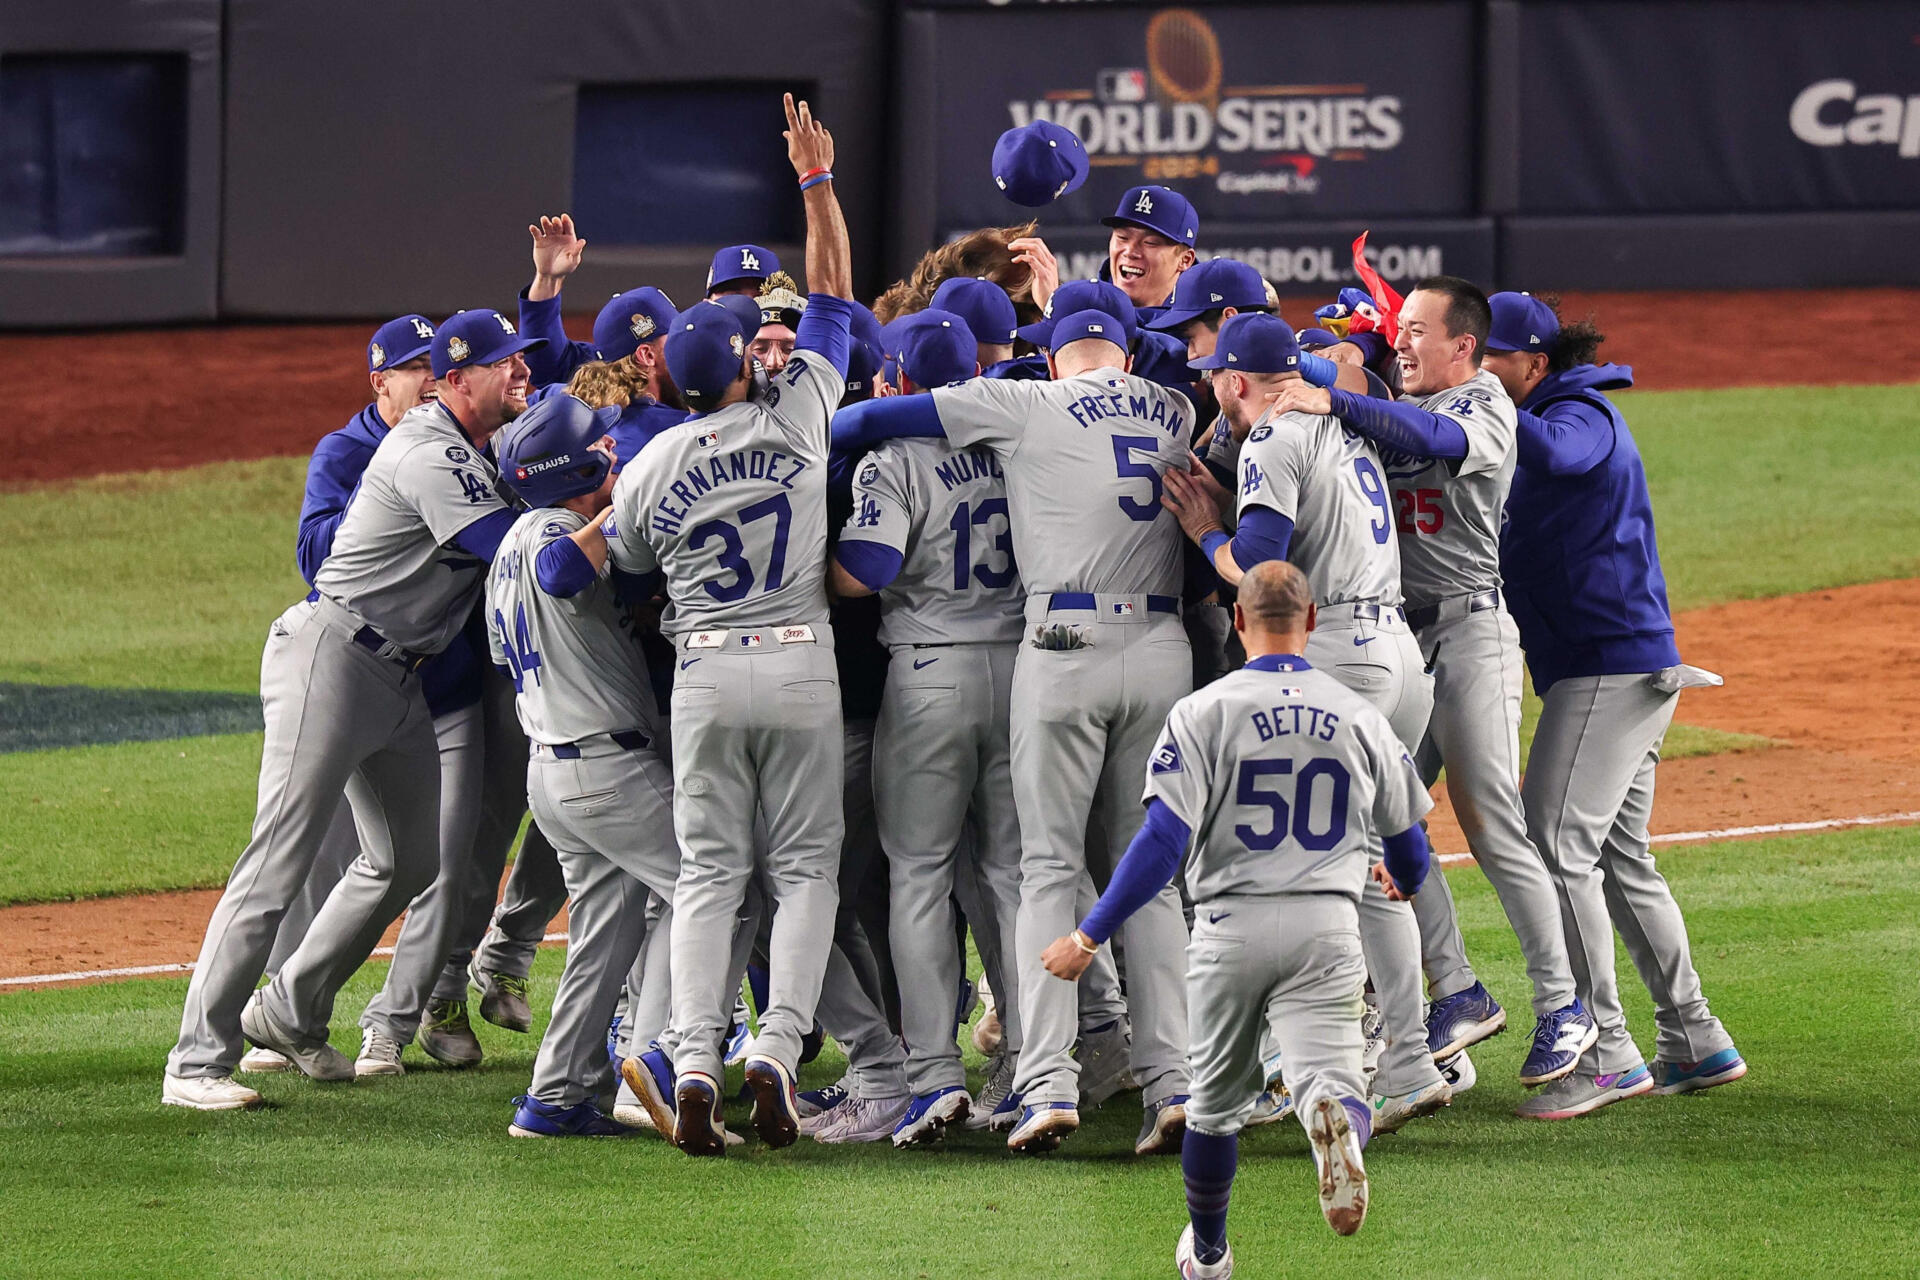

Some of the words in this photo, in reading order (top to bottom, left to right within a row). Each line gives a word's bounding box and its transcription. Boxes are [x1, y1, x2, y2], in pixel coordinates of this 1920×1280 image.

[1216, 97, 1404, 157] SERIES
[1134, 189, 1154, 215] LA
[740, 248, 760, 271] LA
[411, 318, 436, 339] LA
[492, 313, 517, 335] LA
[1066, 393, 1184, 438] FREEMAN
[526, 454, 571, 476] STRAUSS
[934, 450, 1004, 492] MUNC
[1110, 434, 1164, 522] 5
[1243, 457, 1264, 496] LA
[451, 468, 492, 504] LA
[1353, 456, 1391, 545] 9
[857, 493, 882, 528] LA
[1396, 488, 1444, 535] 25
[687, 491, 793, 604] 37
[949, 497, 1019, 591] 13
[1250, 704, 1340, 743] BETTS
[1234, 757, 1352, 852] 50
